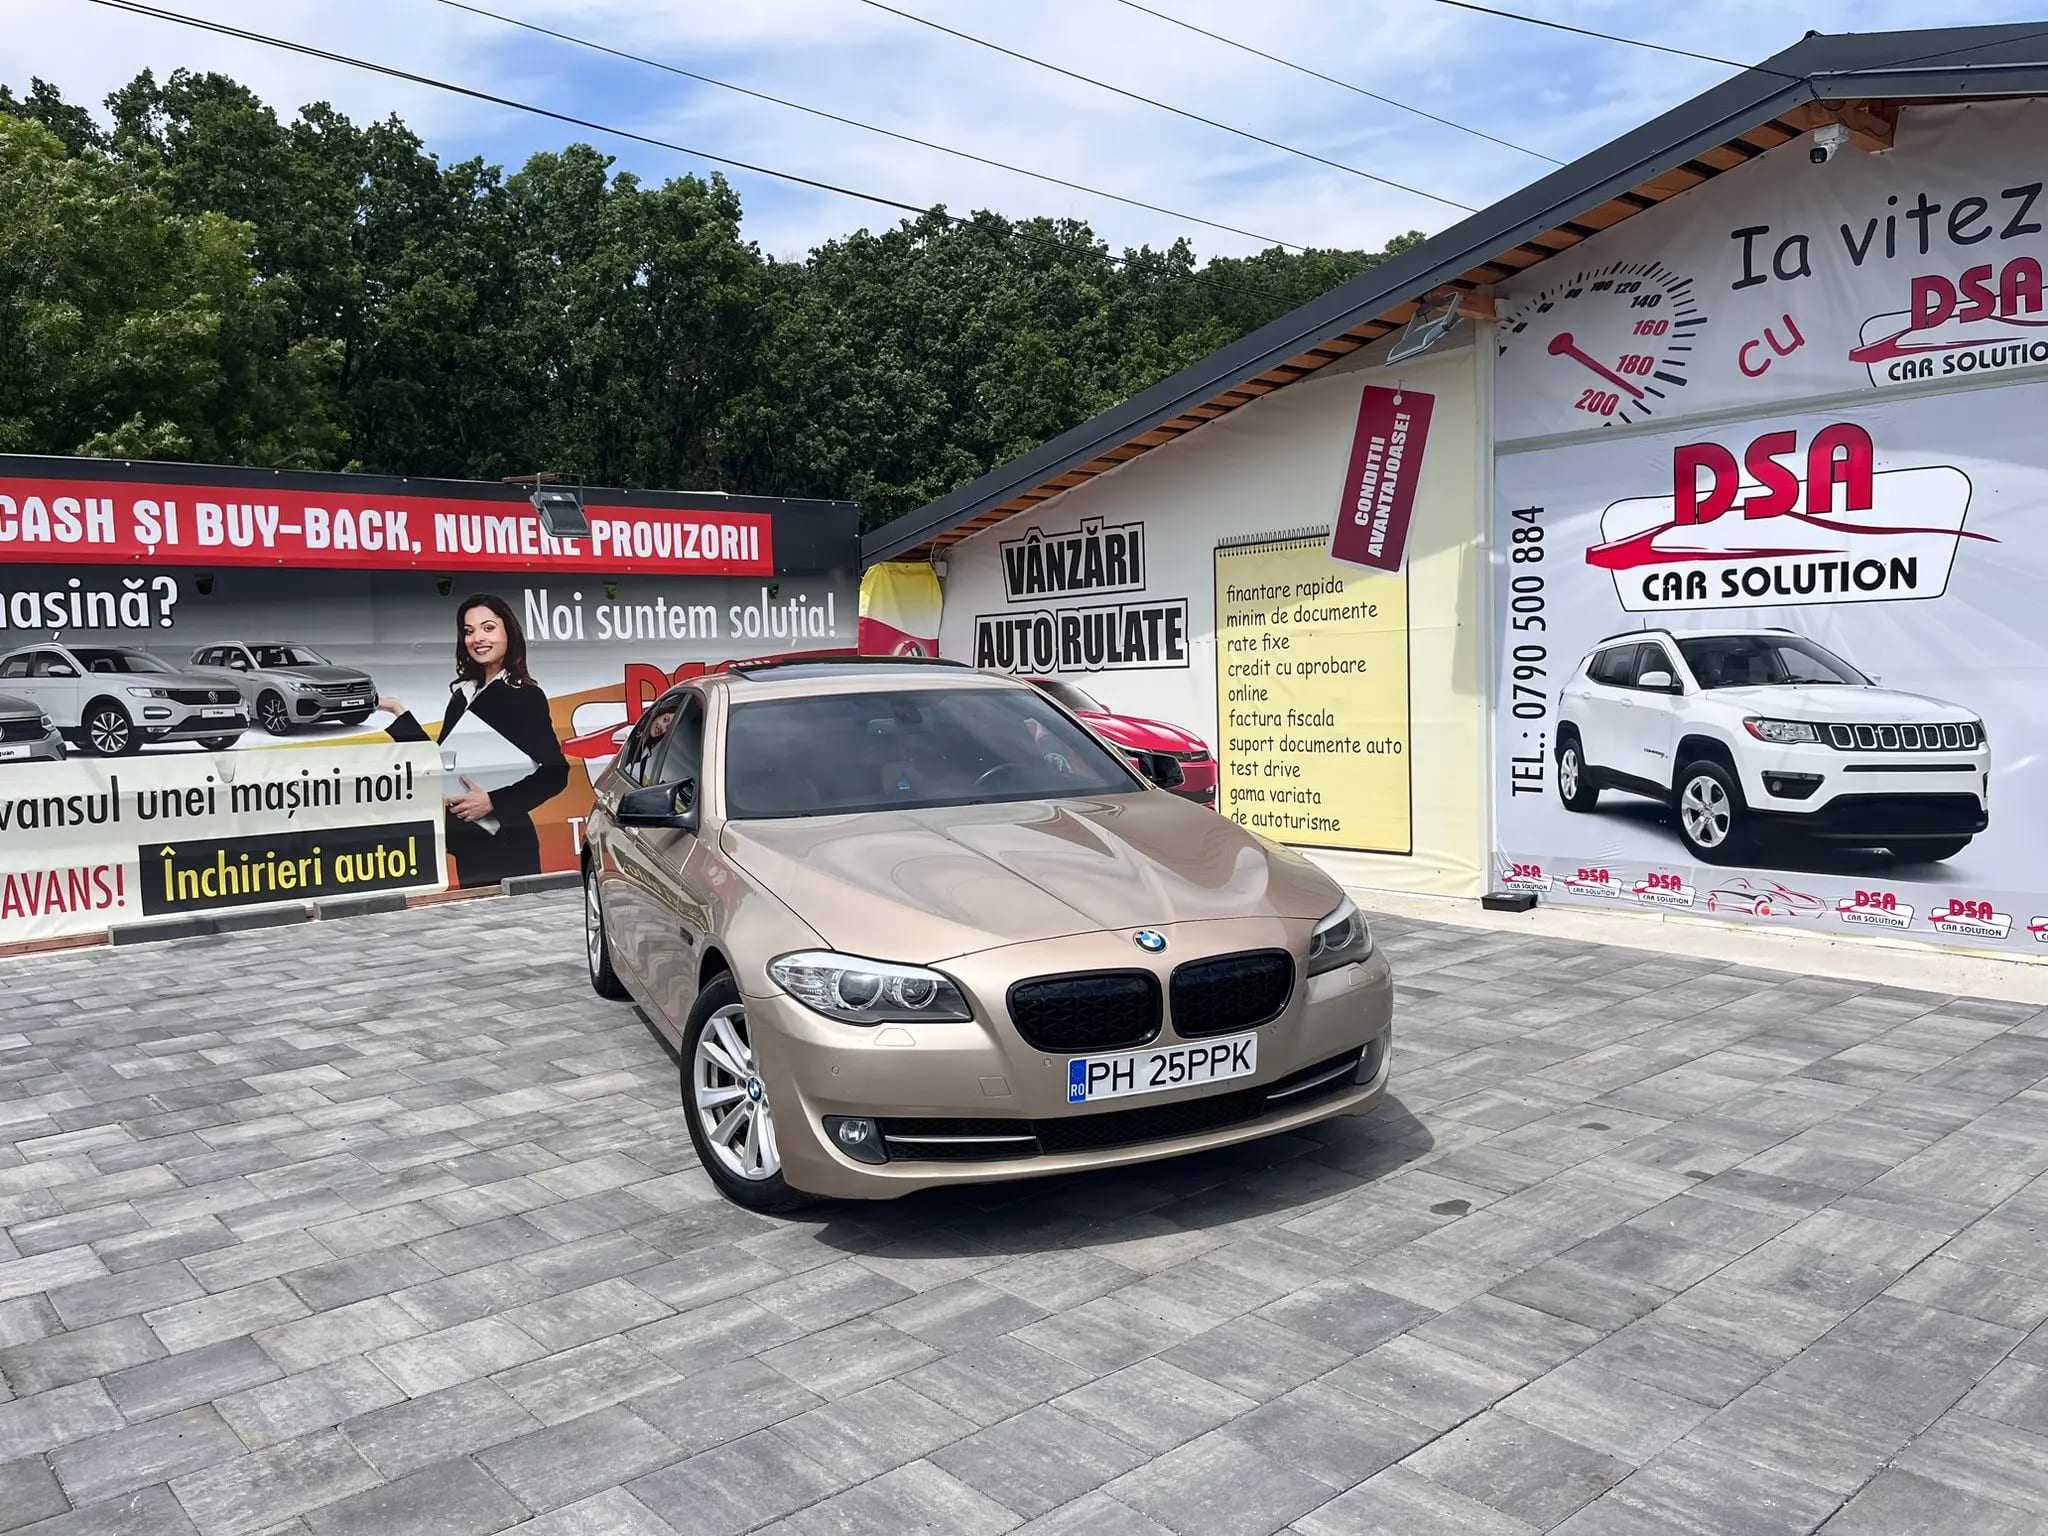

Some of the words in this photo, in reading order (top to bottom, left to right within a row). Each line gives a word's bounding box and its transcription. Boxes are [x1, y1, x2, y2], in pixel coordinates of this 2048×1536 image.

[1731, 225, 1812, 290] Ia
[1614, 281, 1642, 294] 120
[1630, 294, 1661, 308] 140
[1911, 257, 2043, 330] DSA
[1633, 319, 1669, 336] 160
[1738, 314, 1805, 378] cu
[1615, 354, 1654, 376] 180
[1888, 357, 1934, 381] CAR
[1574, 389, 1620, 417] 200
[1354, 436, 1385, 526] CONDITII
[1367, 412, 1411, 558] AVANTAJOASE!
[1674, 422, 1874, 526] DSA
[0, 495, 115, 543] CASH
[133, 499, 179, 555] ȘI
[196, 502, 422, 555] BUY-BACK,
[592, 519, 759, 562] PROVIZORII
[1512, 505, 1545, 563] 884
[1004, 526, 1140, 596] VÂNZĂRI
[1226, 584, 1291, 603] finantare
[1296, 576, 1344, 600] rapida
[1642, 571, 1707, 602] CAR
[1721, 556, 1917, 598] SOLUTION
[1226, 610, 1266, 628] minim
[1271, 606, 1289, 624] de
[1293, 601, 1378, 623] documente
[1513, 575, 1546, 631] 500
[524, 589, 583, 641] Noi
[598, 597, 718, 639] suntem
[730, 587, 836, 648] soluția!
[977, 616, 1056, 669] AUTO
[1061, 607, 1184, 665] RULATE
[1227, 636, 1257, 652] rate
[1262, 632, 1290, 651] fixe
[1228, 659, 1271, 677] credit
[1275, 663, 1292, 675] cu
[1296, 656, 1367, 680] aprobare
[1228, 684, 1268, 702] online
[1512, 644, 1547, 720] 0790
[1229, 710, 1281, 727] factura
[1287, 708, 1334, 728] fiscala
[1229, 736, 1274, 756] suport
[1279, 735, 1361, 753] documente
[1366, 737, 1402, 754] auto
[1229, 760, 1259, 776] test
[1263, 760, 1301, 778] drive
[1512, 731, 1545, 796] TEL.:
[137, 776, 215, 819] unei
[231, 768, 341, 819] mașini
[354, 761, 414, 803] noi!
[1230, 786, 1265, 805] gama
[1269, 787, 1321, 805] variata
[1231, 808, 1247, 825] de
[1251, 811, 1341, 832] autoturisme
[160, 845, 323, 901] Închirieri
[335, 837, 418, 884] auto!
[1513, 864, 1541, 878] DSA
[1578, 868, 1609, 883] DSA
[1648, 872, 1681, 891] DSA
[1, 864, 125, 919] AVANS!
[1657, 896, 1689, 904] SOLUTION
[1855, 890, 1896, 911] DSA
[1847, 914, 1863, 922] CAR
[1864, 916, 1904, 927] SOLUTION
[1949, 899, 1993, 920] DSA
[1941, 923, 1957, 932] CAR
[1959, 925, 2002, 937] SOLUTION
[1071, 1082, 1085, 1097] RO
[1088, 1057, 1134, 1095] PH
[1149, 1040, 1252, 1086] 25PPK
